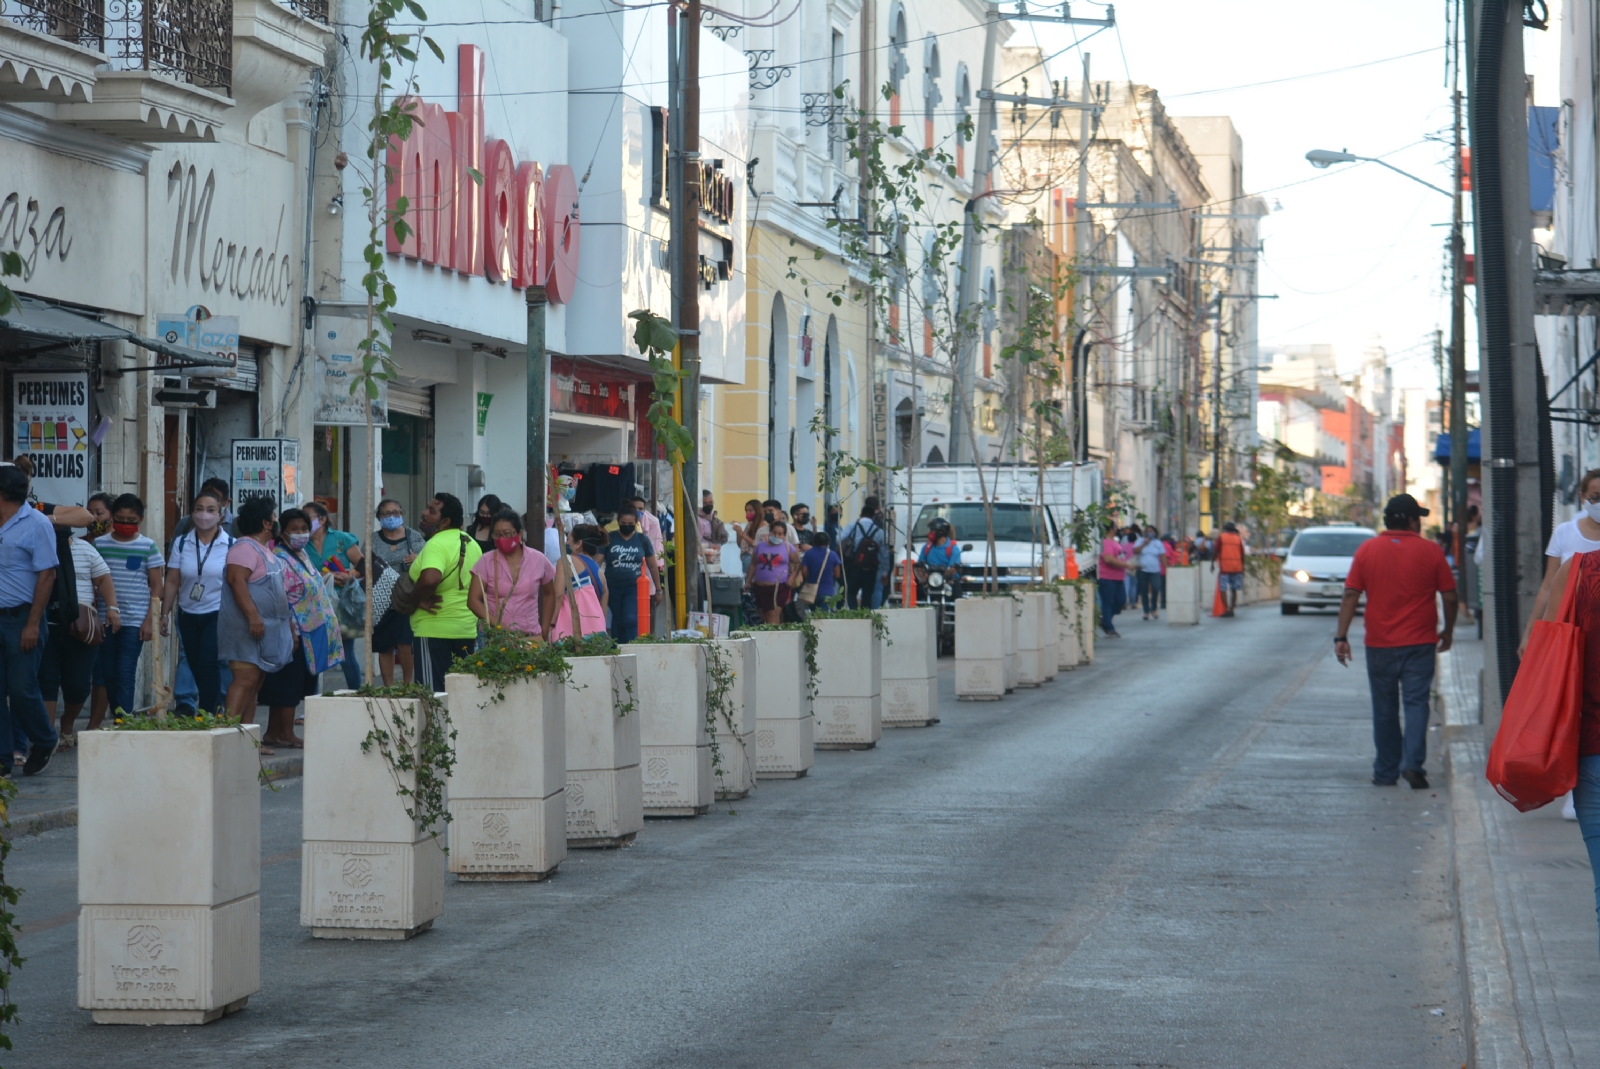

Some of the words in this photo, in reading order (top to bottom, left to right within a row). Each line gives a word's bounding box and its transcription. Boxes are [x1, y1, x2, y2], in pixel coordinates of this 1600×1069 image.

[387, 44, 580, 304] milano
[168, 159, 293, 306] Mercado
[326, 369, 347, 378] PAGA
[18, 381, 85, 406] PERFUMES
[236, 446, 277, 461] PERFUMES
[22, 453, 84, 478] SENCIAS
[328, 890, 386, 903] Yucatán
[111, 964, 180, 980] Yucatán
